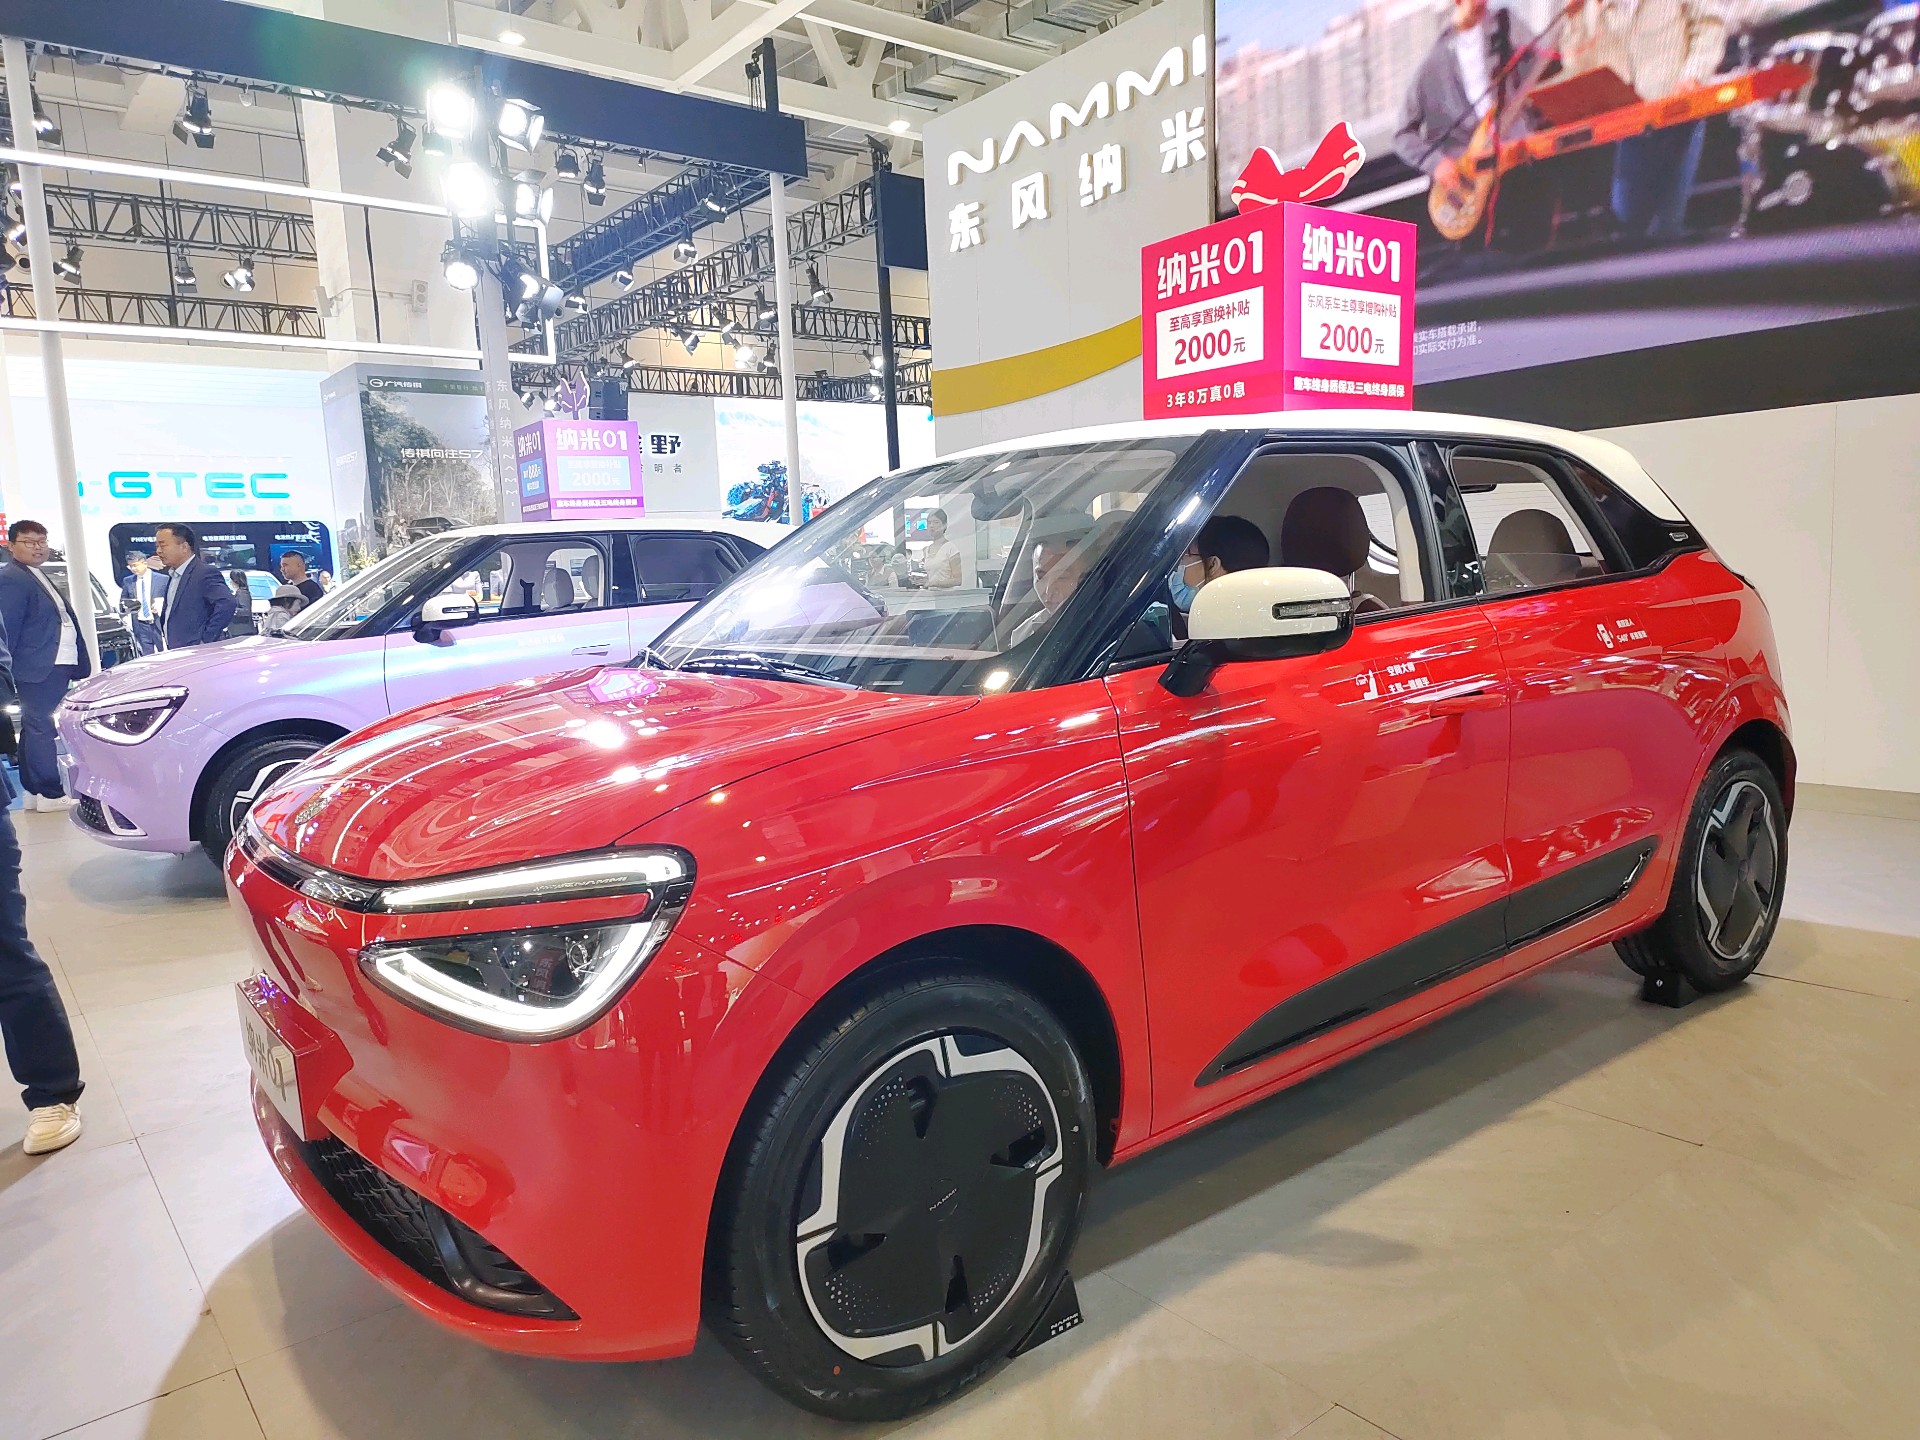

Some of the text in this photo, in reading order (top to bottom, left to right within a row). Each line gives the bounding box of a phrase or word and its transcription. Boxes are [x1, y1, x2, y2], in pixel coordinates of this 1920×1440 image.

[947, 33, 1206, 186] NAMMI
[948, 106, 1207, 253] 东风纳米
[1156, 229, 1264, 301] 纳米01
[1302, 222, 1401, 283] 纳米01
[1168, 298, 1251, 333] 至高享置换补贴
[1307, 294, 1398, 318] 东风系车主尊享增购补贴
[1173, 328, 1246, 366] 2000元
[1318, 322, 1385, 354] 2000元
[1165, 381, 1246, 408] 3年8万真0息
[401, 447, 483, 459] 传祺向往S7
[517, 430, 542, 458] 纳米01
[555, 427, 628, 451] 纳米01
[929, 1188, 957, 1211] NAMMI
[1050, 1312, 1079, 1330] NAMMI
